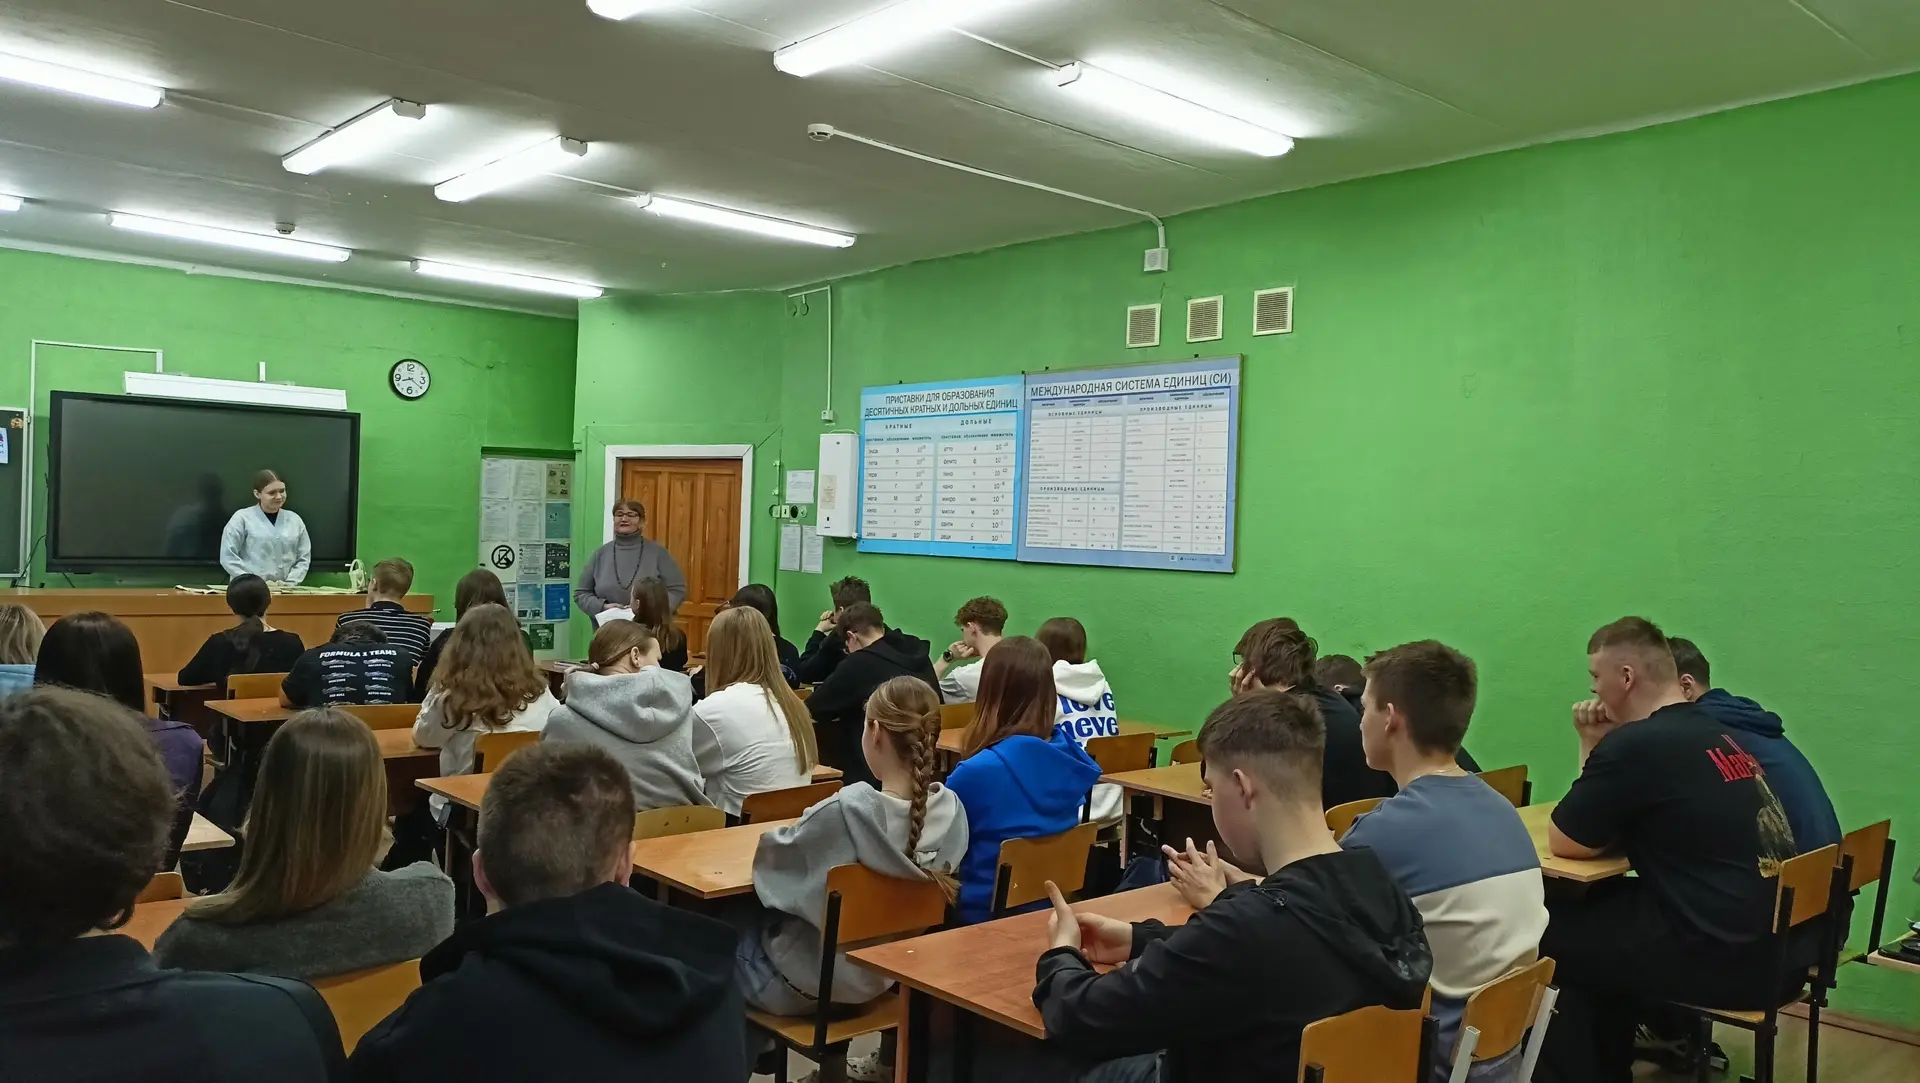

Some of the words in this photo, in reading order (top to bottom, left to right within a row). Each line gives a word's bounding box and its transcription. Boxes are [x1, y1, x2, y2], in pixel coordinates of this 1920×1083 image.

[406, 363, 415, 372] 12
[394, 373, 401, 382] 9
[419, 376, 426, 385] 3
[1031, 382, 1112, 396] МЕЖДУНАРОДНАЯ
[1116, 378, 1160, 392] СИСТЕМА
[1164, 374, 1206, 388] ЕДИНИЦ
[1209, 372, 1232, 386] (СИ)
[406, 386, 413, 394] 6
[886, 393, 925, 404] ПРИСТАВКИ
[926, 392, 940, 402] ДЛЯ
[942, 388, 994, 401] ОБРАЗОВАНИЯ
[864, 406, 909, 417] ДЕСЯТИЧНЫХ
[910, 404, 942, 414] КРАТНЫХ
[942, 403, 948, 412] И
[948, 400, 984, 413] ДОЛЬНЫХ
[986, 398, 1018, 410] ЕДИНИЦ
